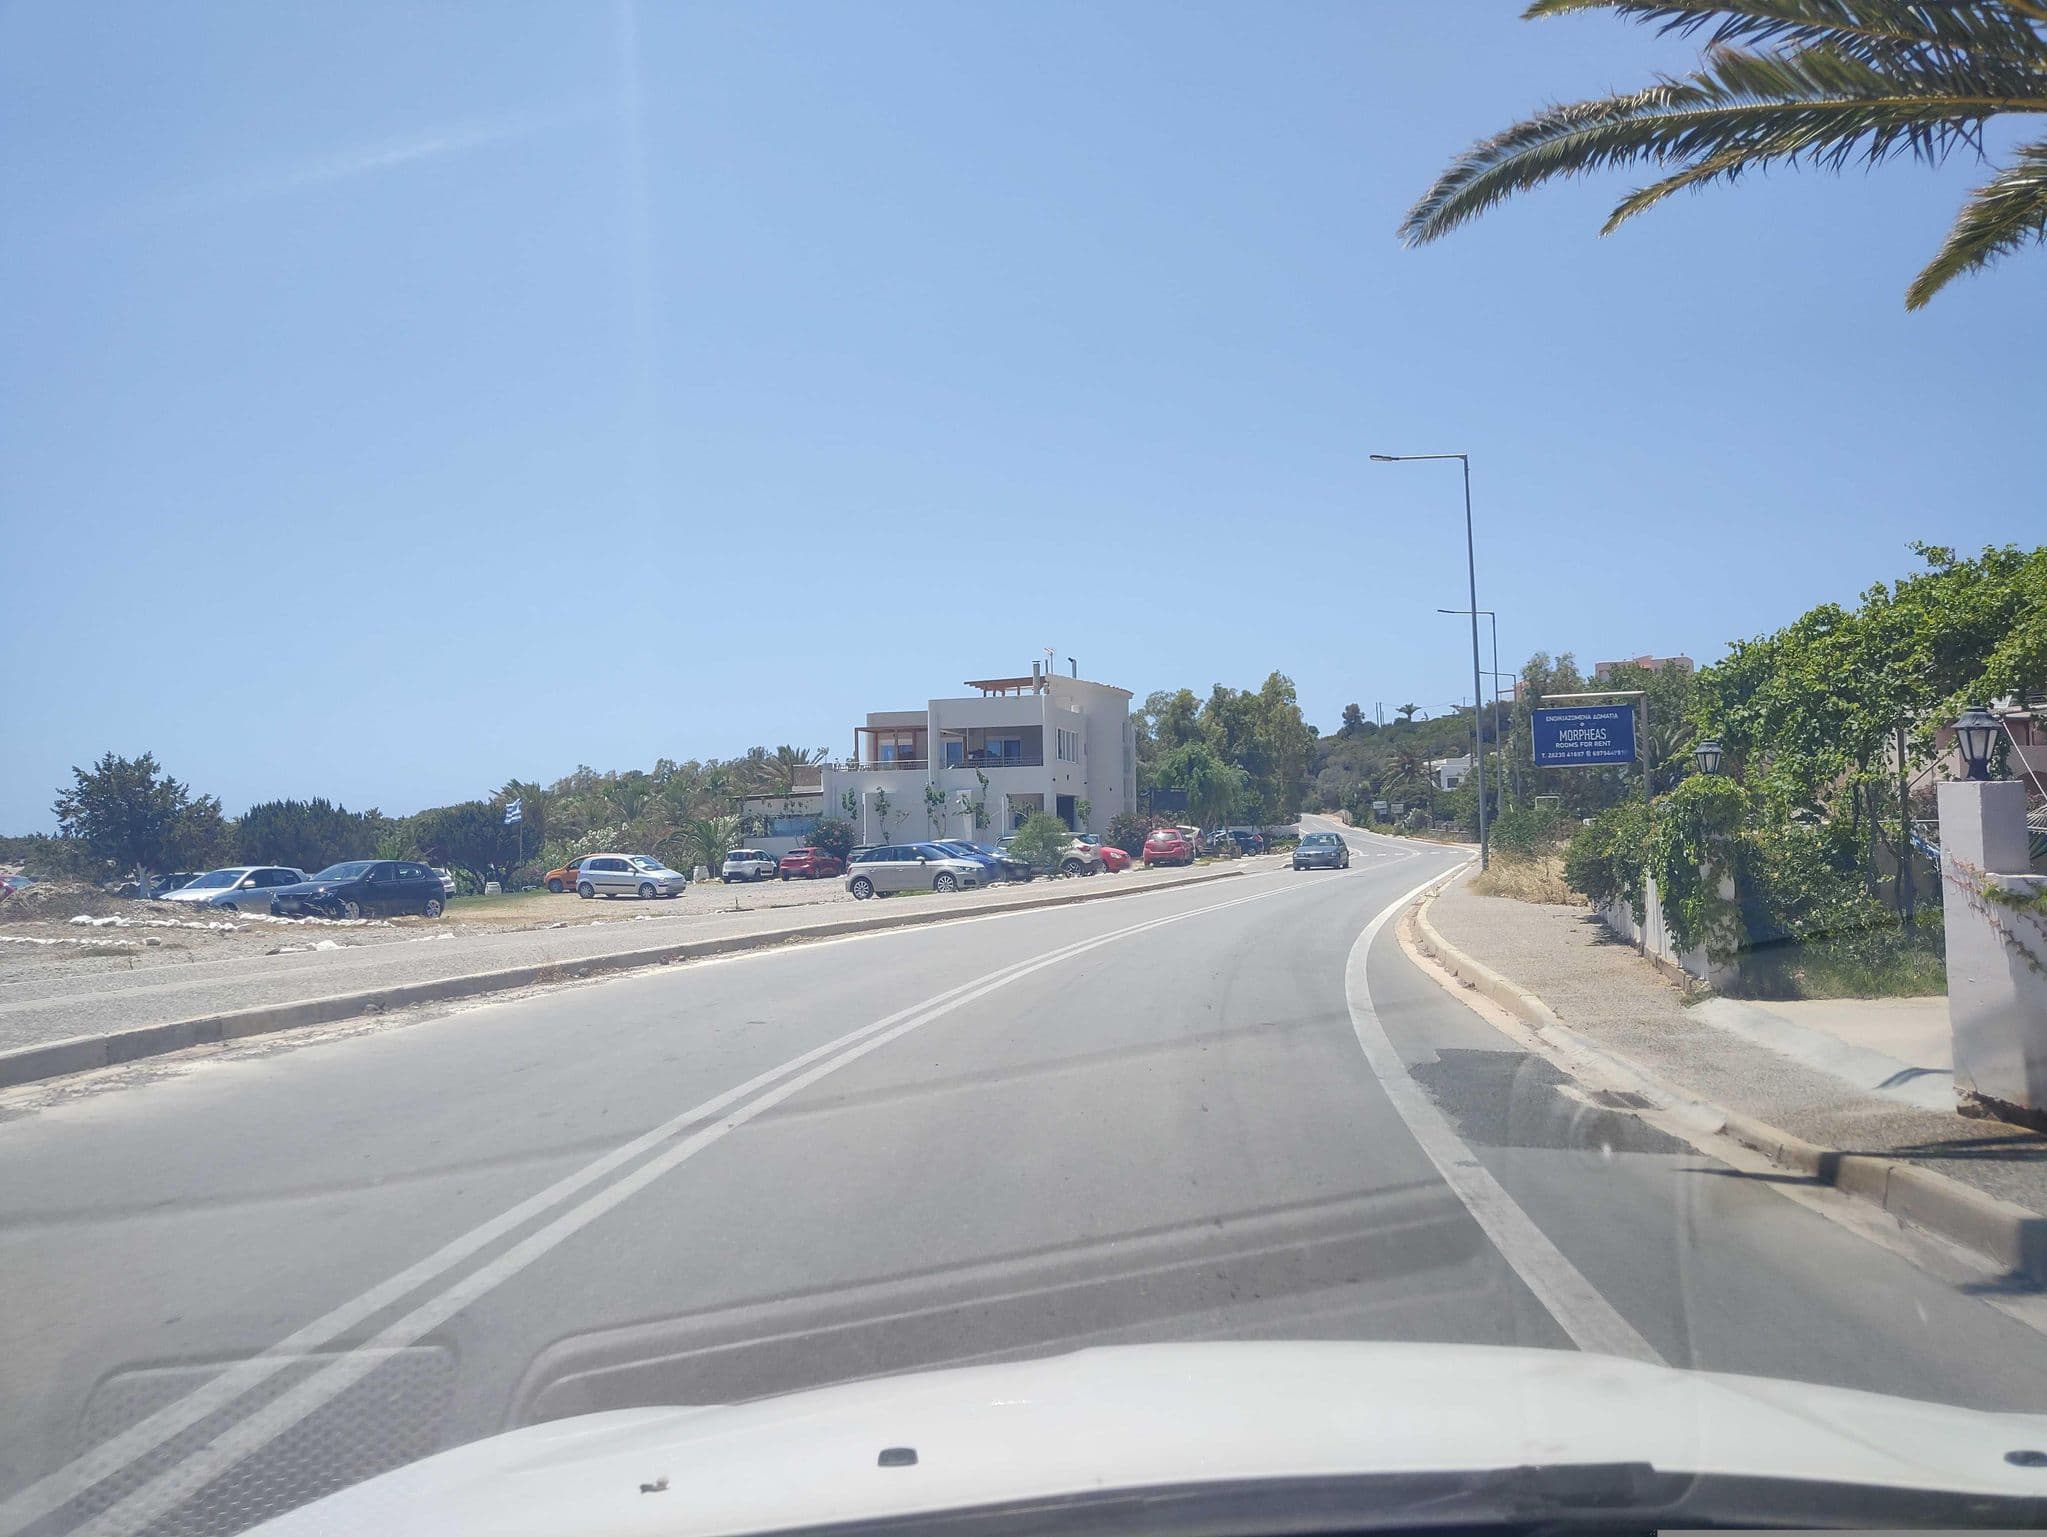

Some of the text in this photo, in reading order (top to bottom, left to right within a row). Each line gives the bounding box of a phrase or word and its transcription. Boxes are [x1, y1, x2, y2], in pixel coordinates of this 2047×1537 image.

[1559, 728, 1607, 742] MORPHEAS
[1555, 741, 1579, 749] ROOMS
[1580, 740, 1593, 748] FOR
